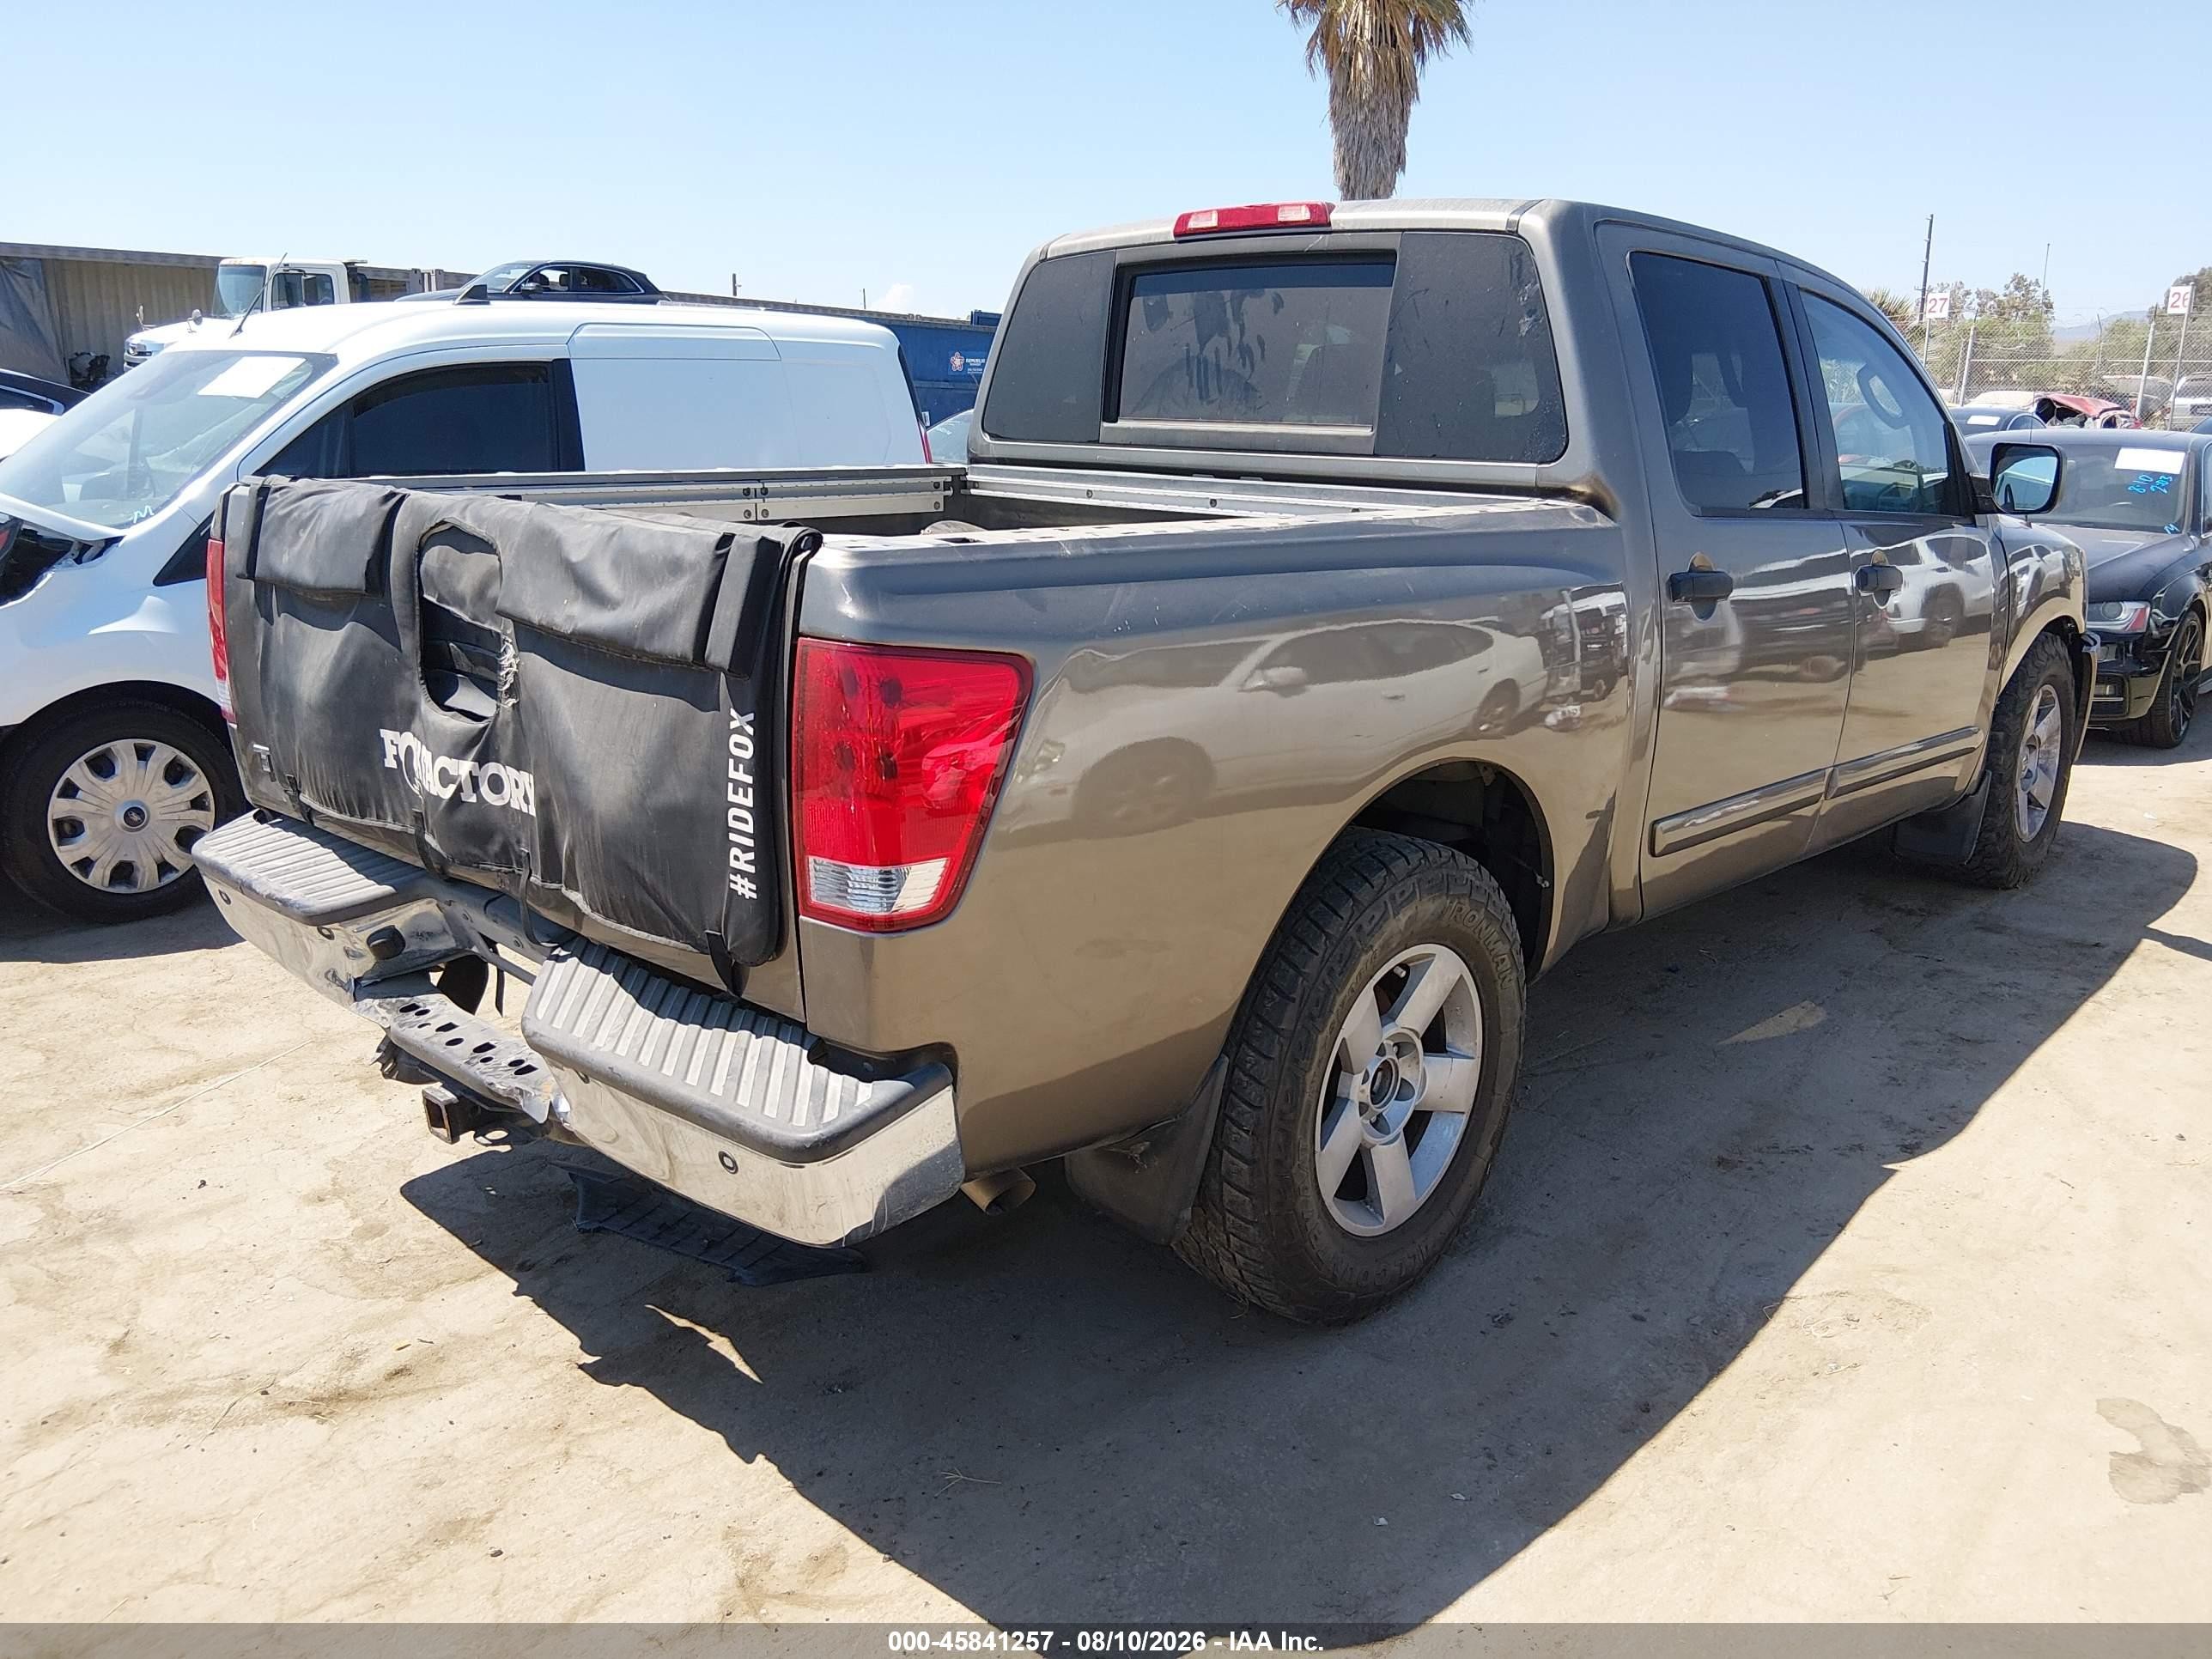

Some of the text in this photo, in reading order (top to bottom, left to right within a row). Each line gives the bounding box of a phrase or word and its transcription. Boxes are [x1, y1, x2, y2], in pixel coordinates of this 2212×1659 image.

[1928, 298, 1948, 313] 27
[2170, 292, 2189, 308] 26
[727, 708, 757, 900] #RIDEFOX
[1440, 898, 1515, 990] IRONMAN
